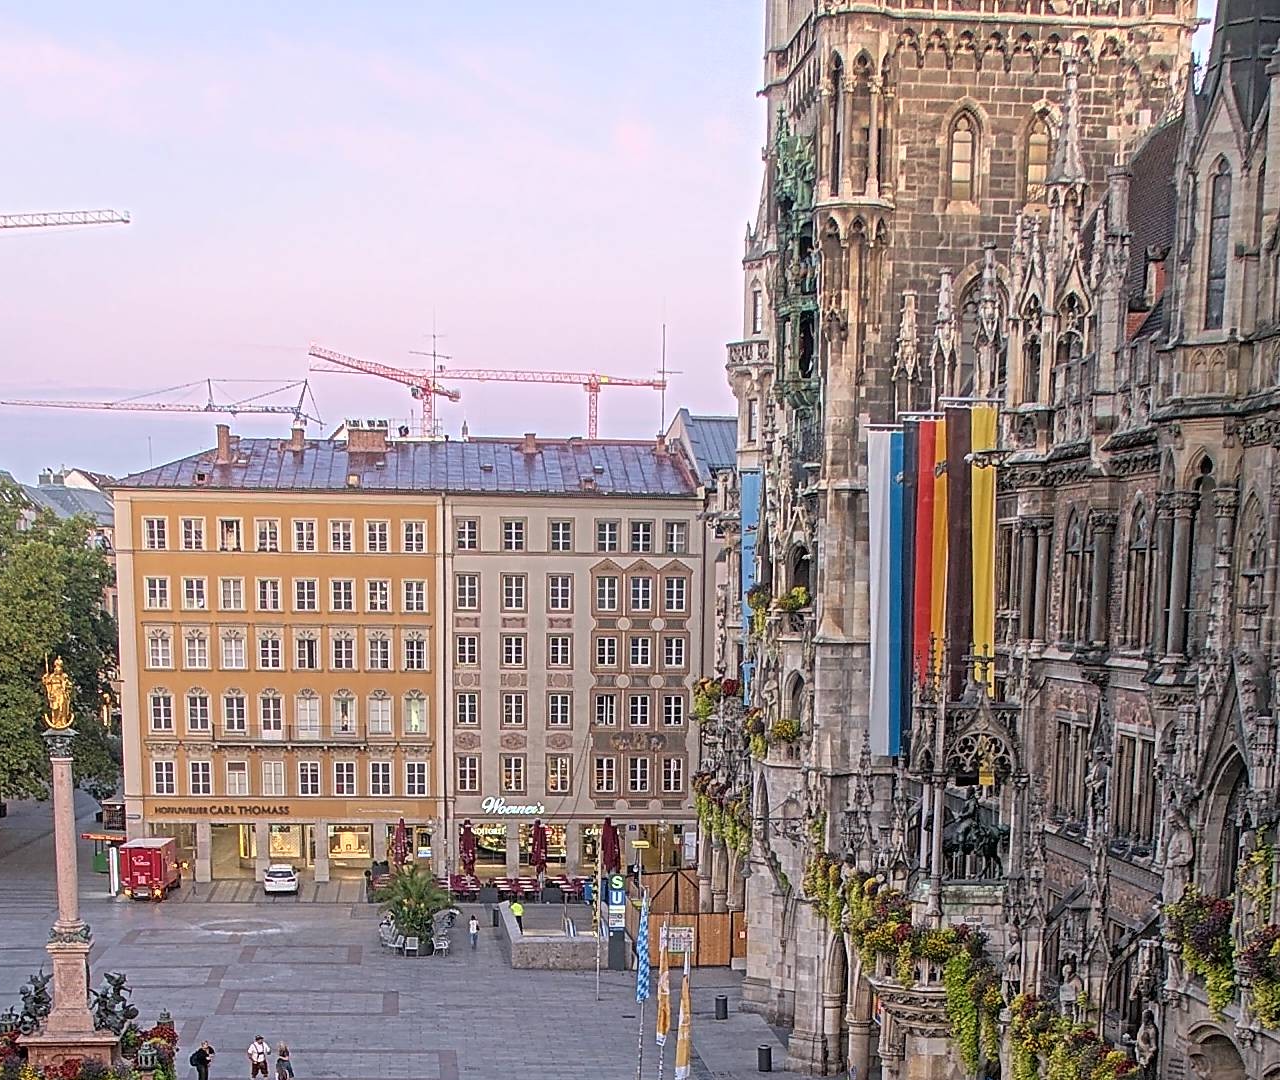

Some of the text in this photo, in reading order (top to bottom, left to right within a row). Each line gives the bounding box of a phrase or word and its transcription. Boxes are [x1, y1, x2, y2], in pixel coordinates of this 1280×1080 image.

[209, 805, 237, 815] CARL
[237, 805, 290, 816] THOMASS
[611, 875, 624, 889] S
[613, 890, 623, 904] U
